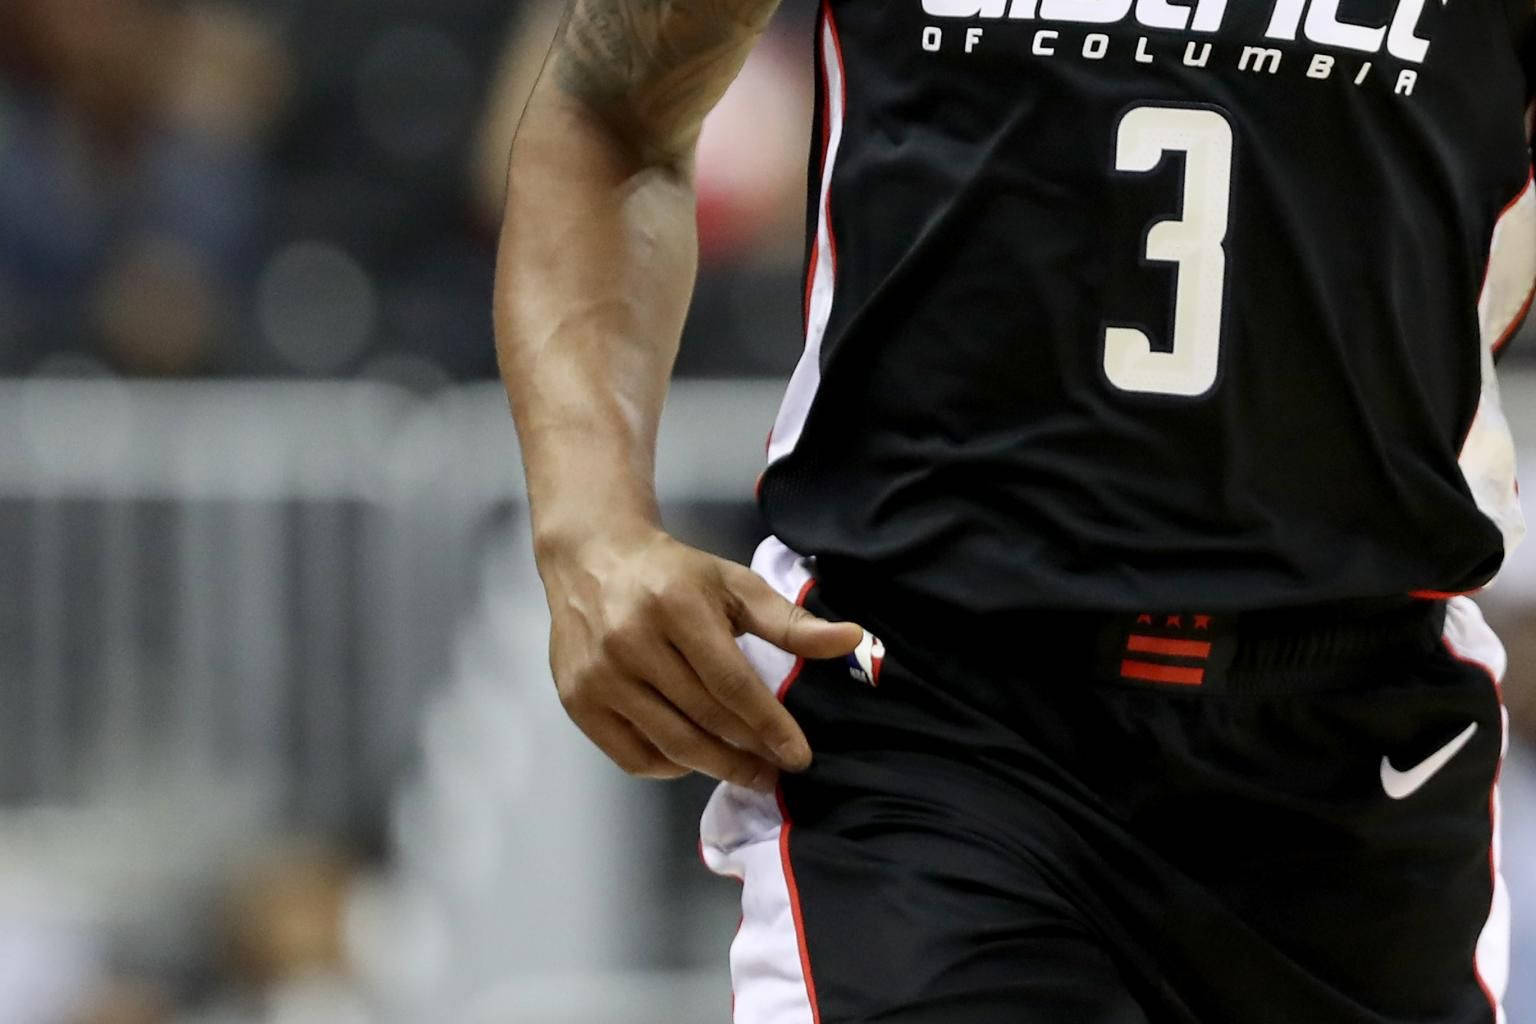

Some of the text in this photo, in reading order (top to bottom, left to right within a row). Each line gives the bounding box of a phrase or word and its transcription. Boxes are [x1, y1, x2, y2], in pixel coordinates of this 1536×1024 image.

[921, 26, 1418, 96] OF COLUMBIA
[1103, 106, 1233, 396] 3
